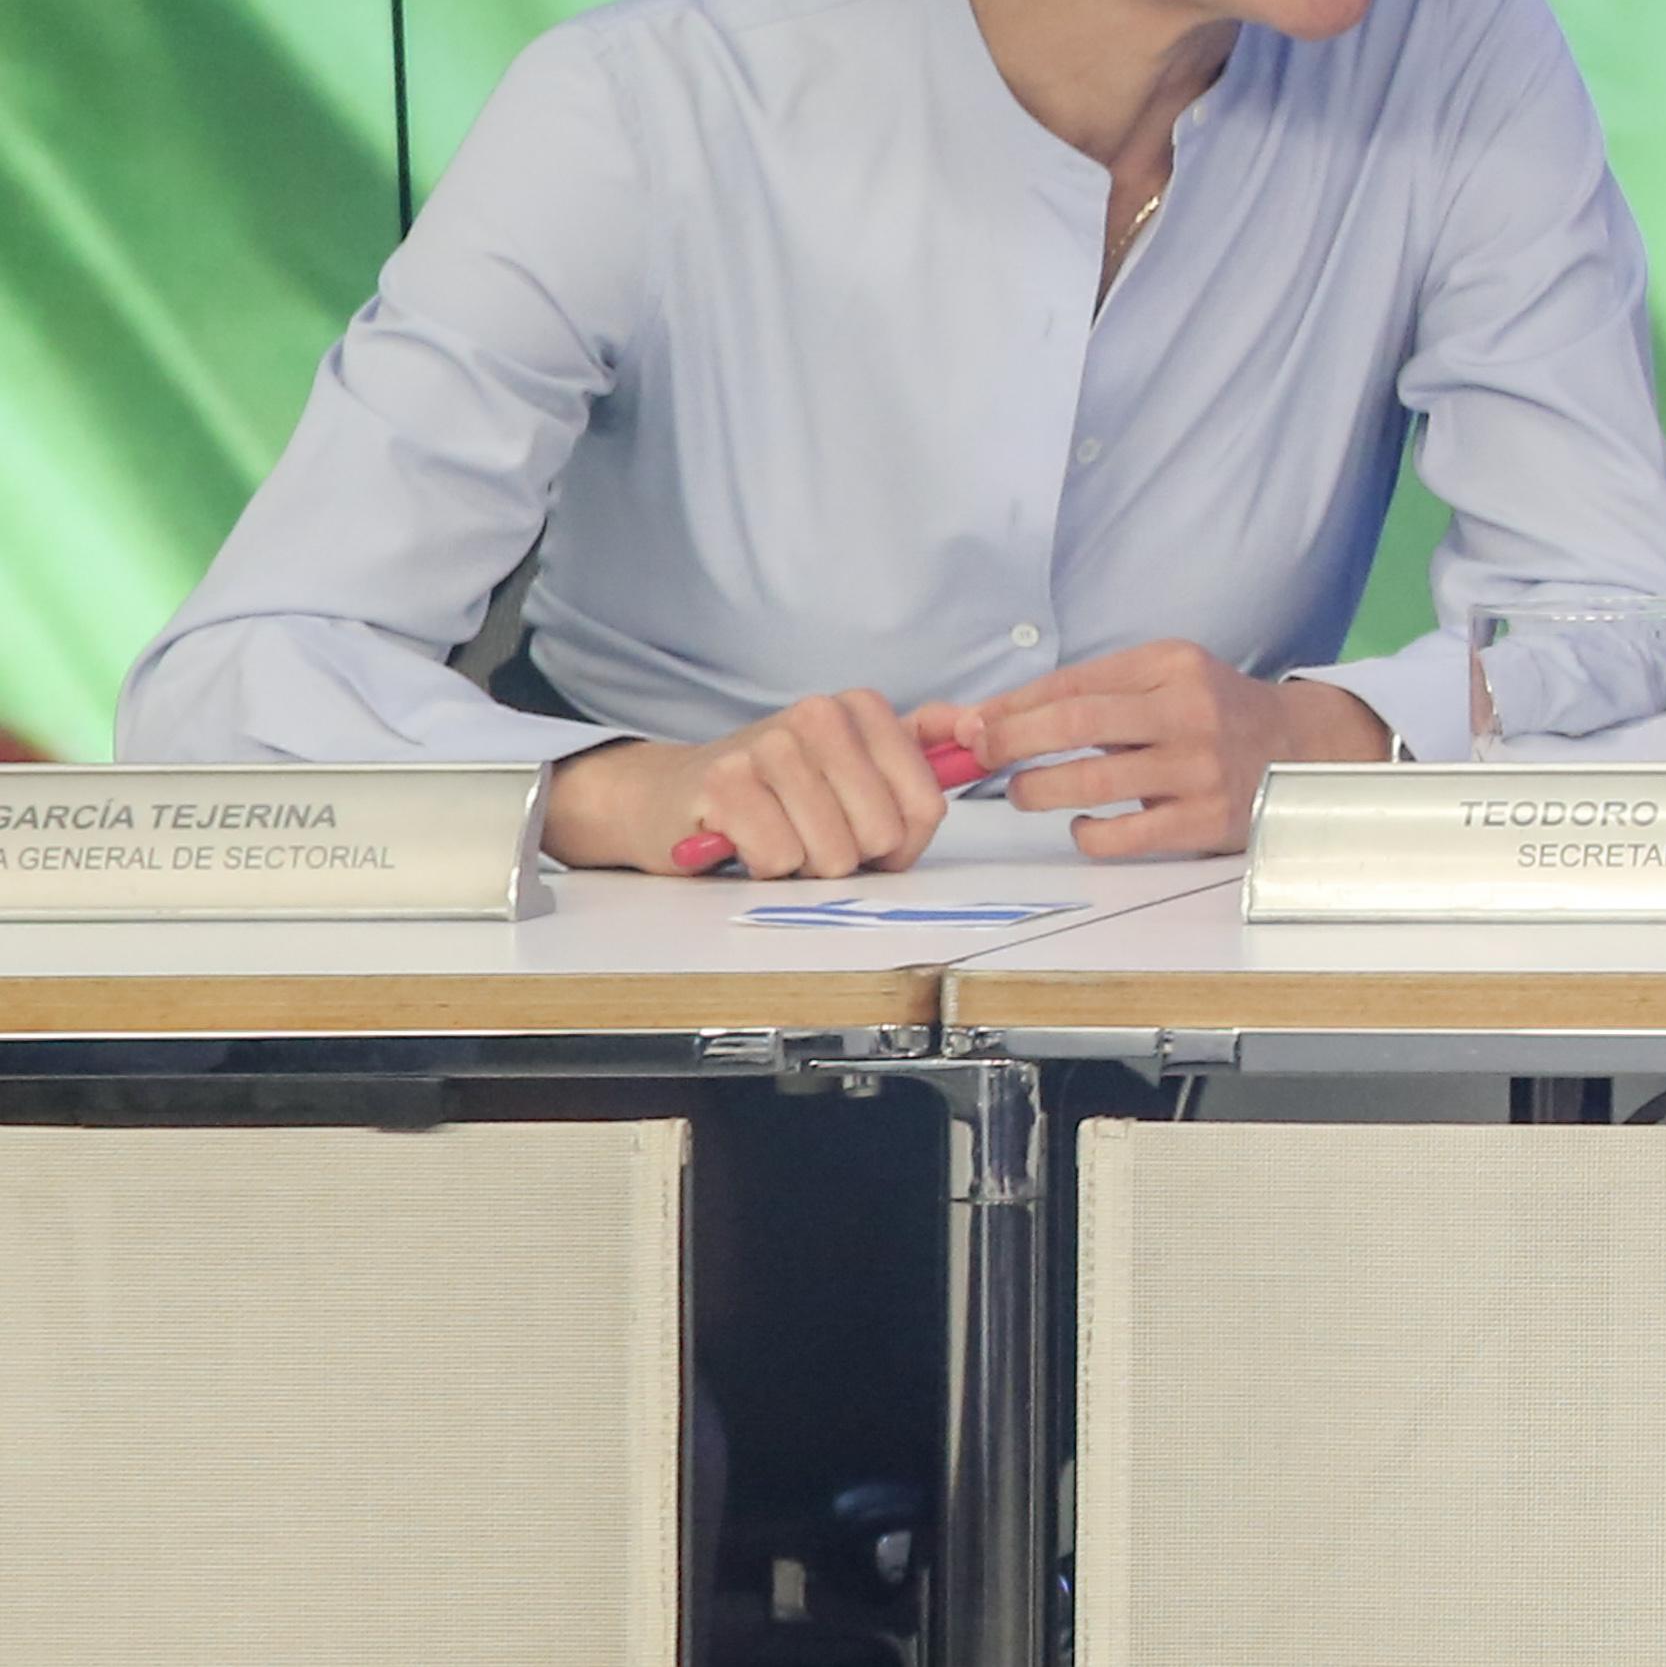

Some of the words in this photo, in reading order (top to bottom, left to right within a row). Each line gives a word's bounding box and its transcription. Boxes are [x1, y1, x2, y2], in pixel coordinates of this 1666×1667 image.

[0, 798, 134, 830] GARCÍA
[151, 803, 336, 829] TEJERINA
[1459, 800, 1658, 827] TEODORO
[18, 846, 162, 871] GENERAL
[172, 846, 214, 870] DE
[223, 845, 395, 870] SECTORIAL
